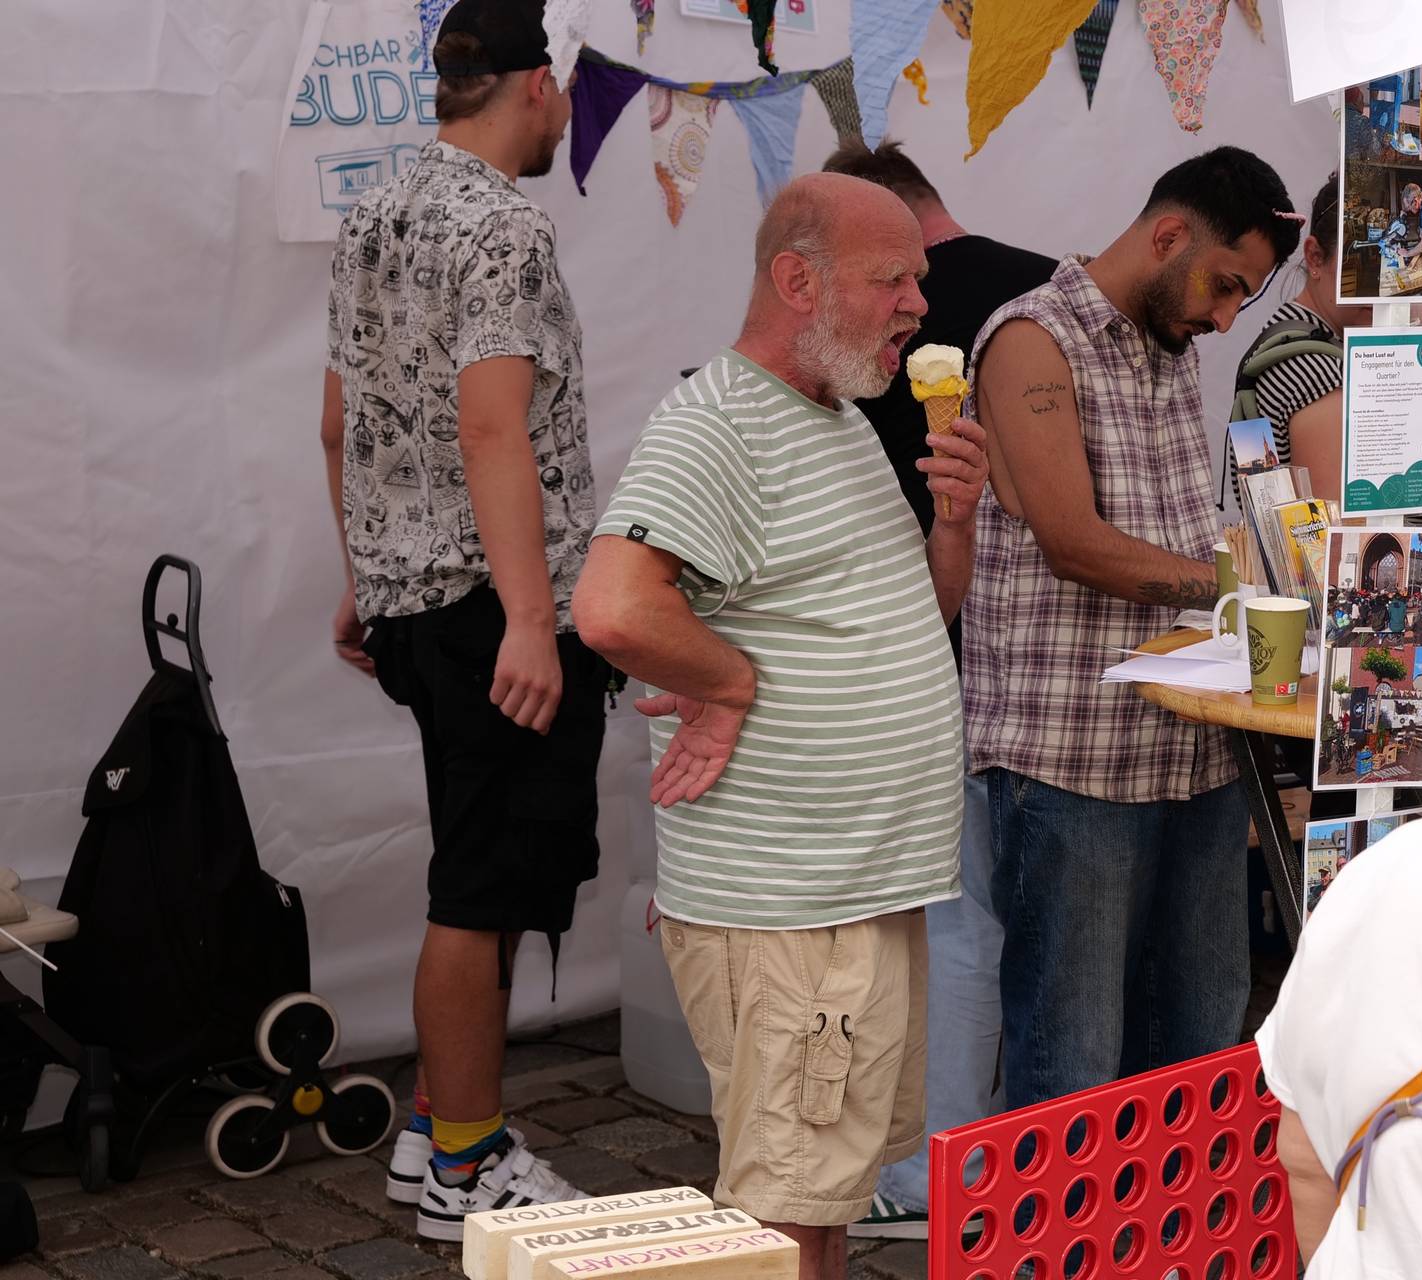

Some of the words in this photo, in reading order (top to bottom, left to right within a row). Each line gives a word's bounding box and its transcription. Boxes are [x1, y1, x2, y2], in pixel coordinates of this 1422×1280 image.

[312, 40, 401, 67] CHBAR
[290, 70, 440, 126] BUDE
[1361, 361, 1394, 371] Engagement
[491, 1190, 705, 1225] PARTIZIPATION
[523, 1211, 747, 1249] INTEGRATION
[566, 1230, 788, 1274] WISSENSCHAFT
